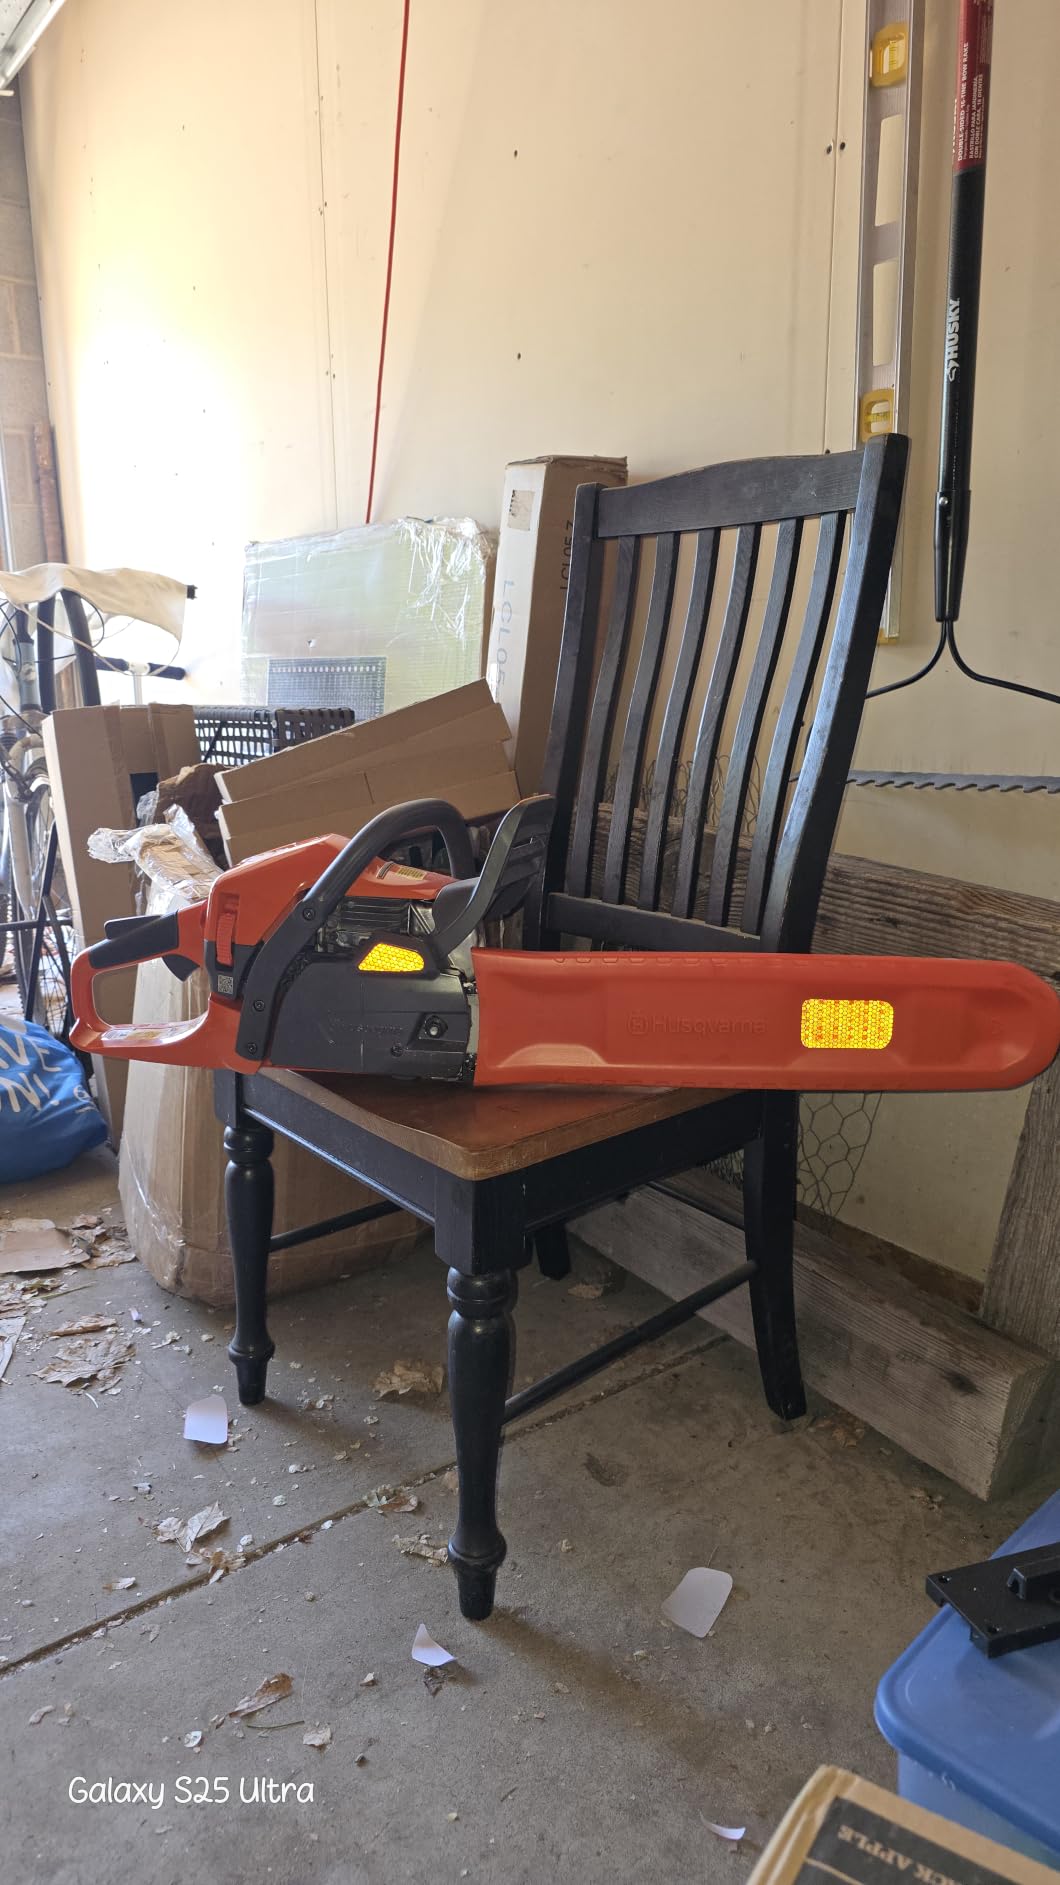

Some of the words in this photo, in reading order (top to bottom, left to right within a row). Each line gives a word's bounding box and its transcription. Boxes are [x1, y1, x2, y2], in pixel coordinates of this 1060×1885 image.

[947, 298, 960, 360] HUSKY
[652, 1014, 767, 1040] Husqvarna
[837, 1824, 913, 1871] APPLE
